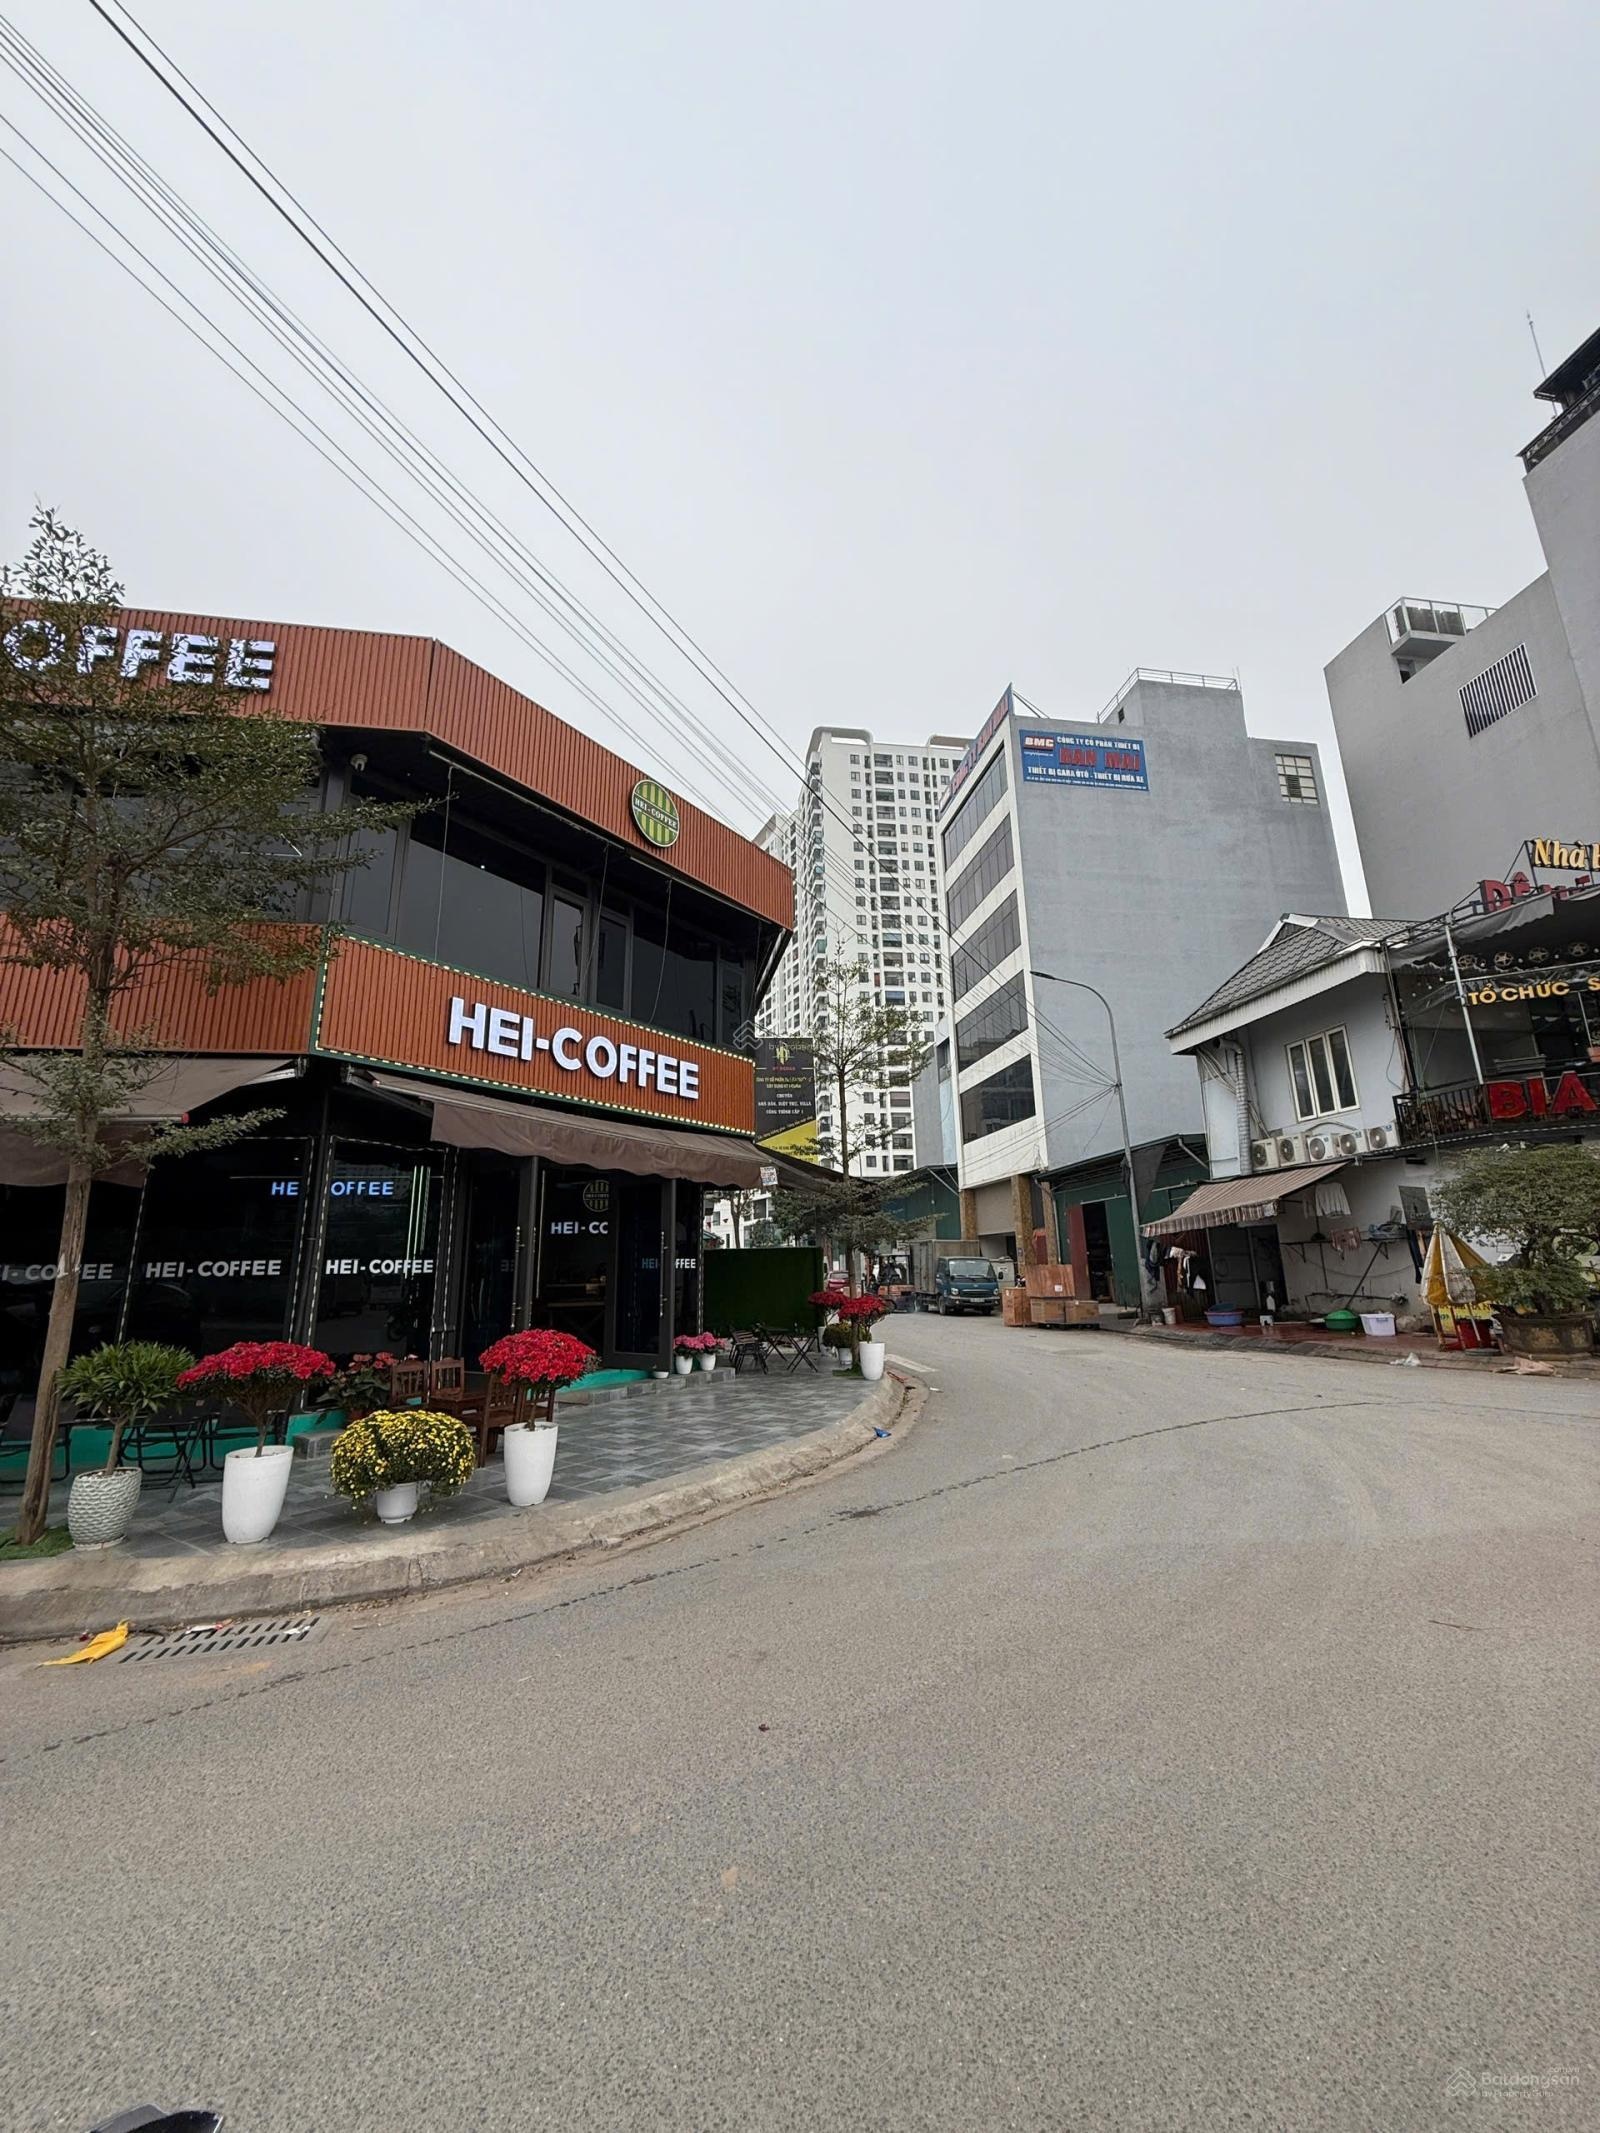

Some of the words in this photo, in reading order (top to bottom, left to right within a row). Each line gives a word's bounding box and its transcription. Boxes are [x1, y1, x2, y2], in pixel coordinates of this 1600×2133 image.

[1025, 737, 1054, 747] BMC
[1531, 838, 1587, 869] Nhà
[1468, 982, 1497, 1006] TỔ
[1500, 979, 1570, 1002] CHỨC
[448, 996, 699, 1100] HEI-COFFEE
[1486, 1071, 1598, 1120] BIA
